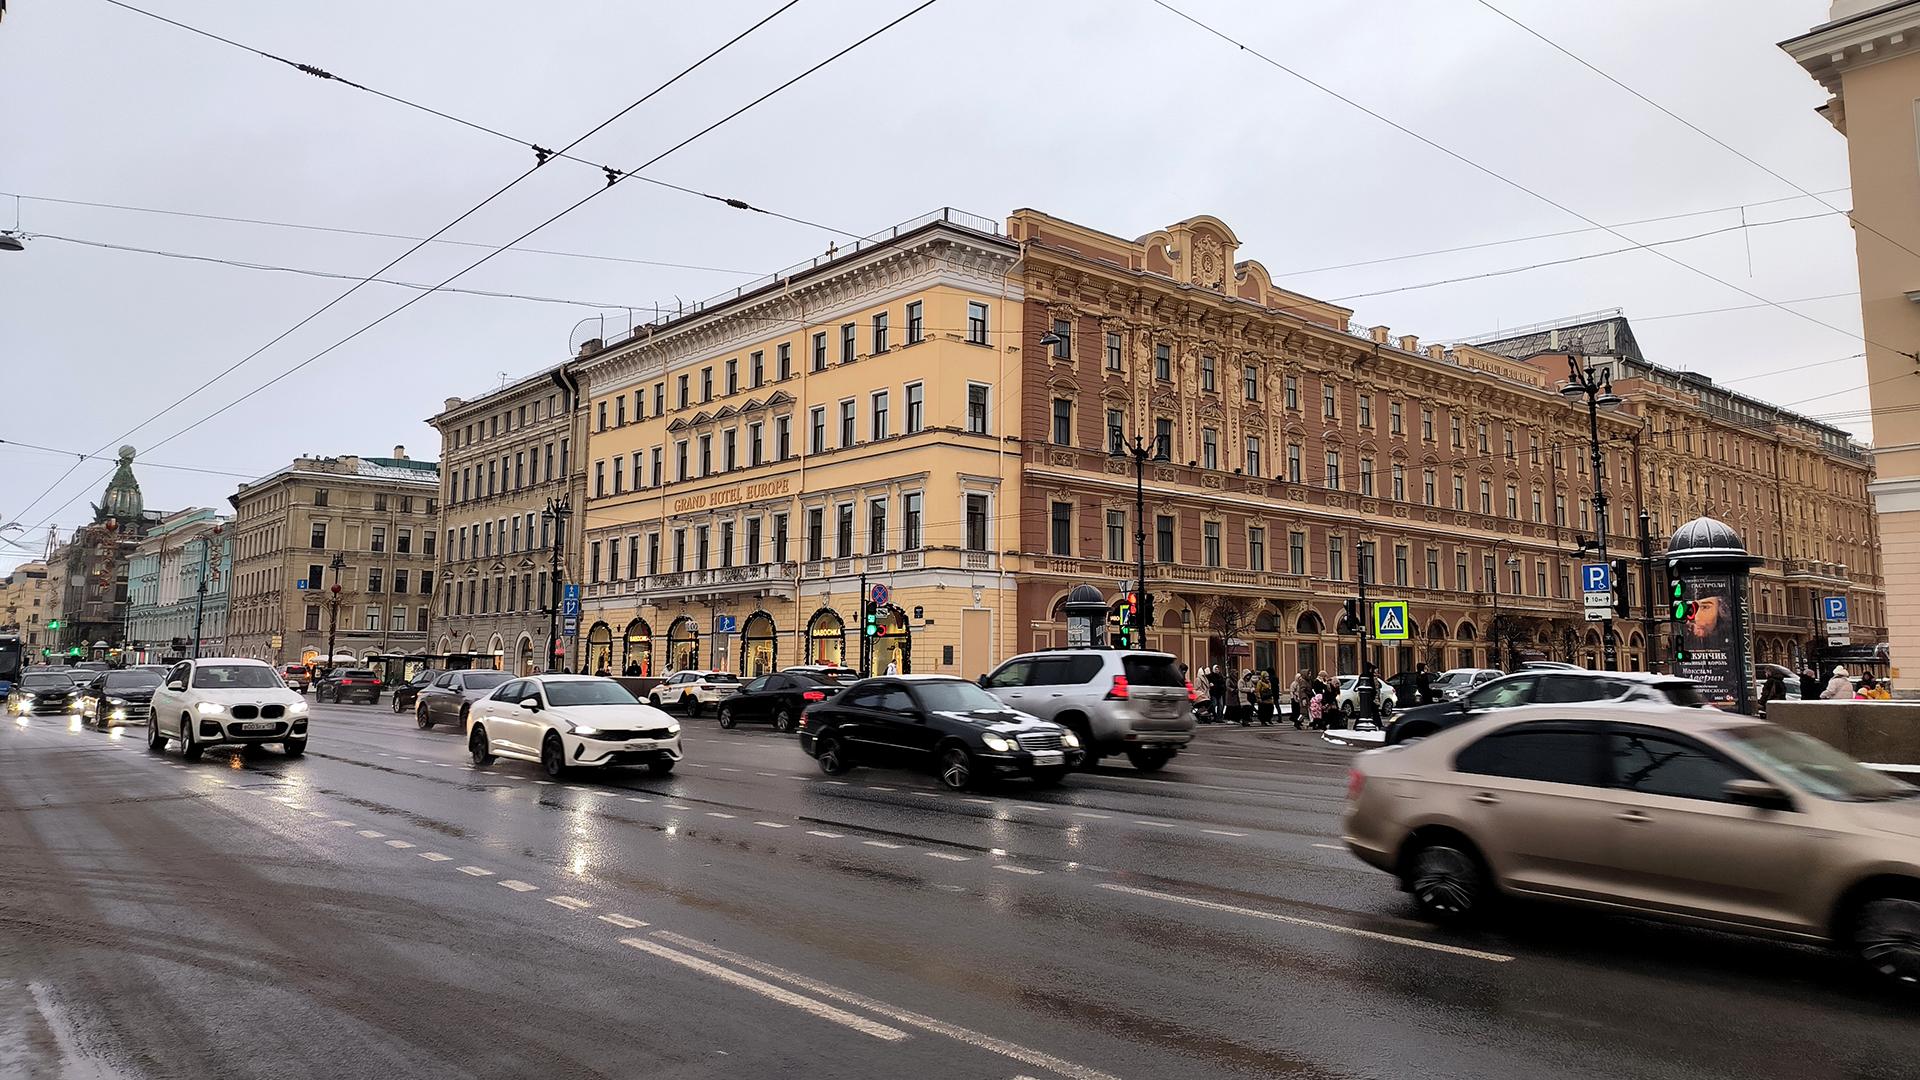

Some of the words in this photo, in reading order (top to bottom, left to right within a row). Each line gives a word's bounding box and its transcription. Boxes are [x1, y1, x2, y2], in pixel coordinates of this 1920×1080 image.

[674, 495, 706, 512] GRAND
[709, 487, 743, 506] HOTEL
[746, 479, 790, 500] EUROPE
